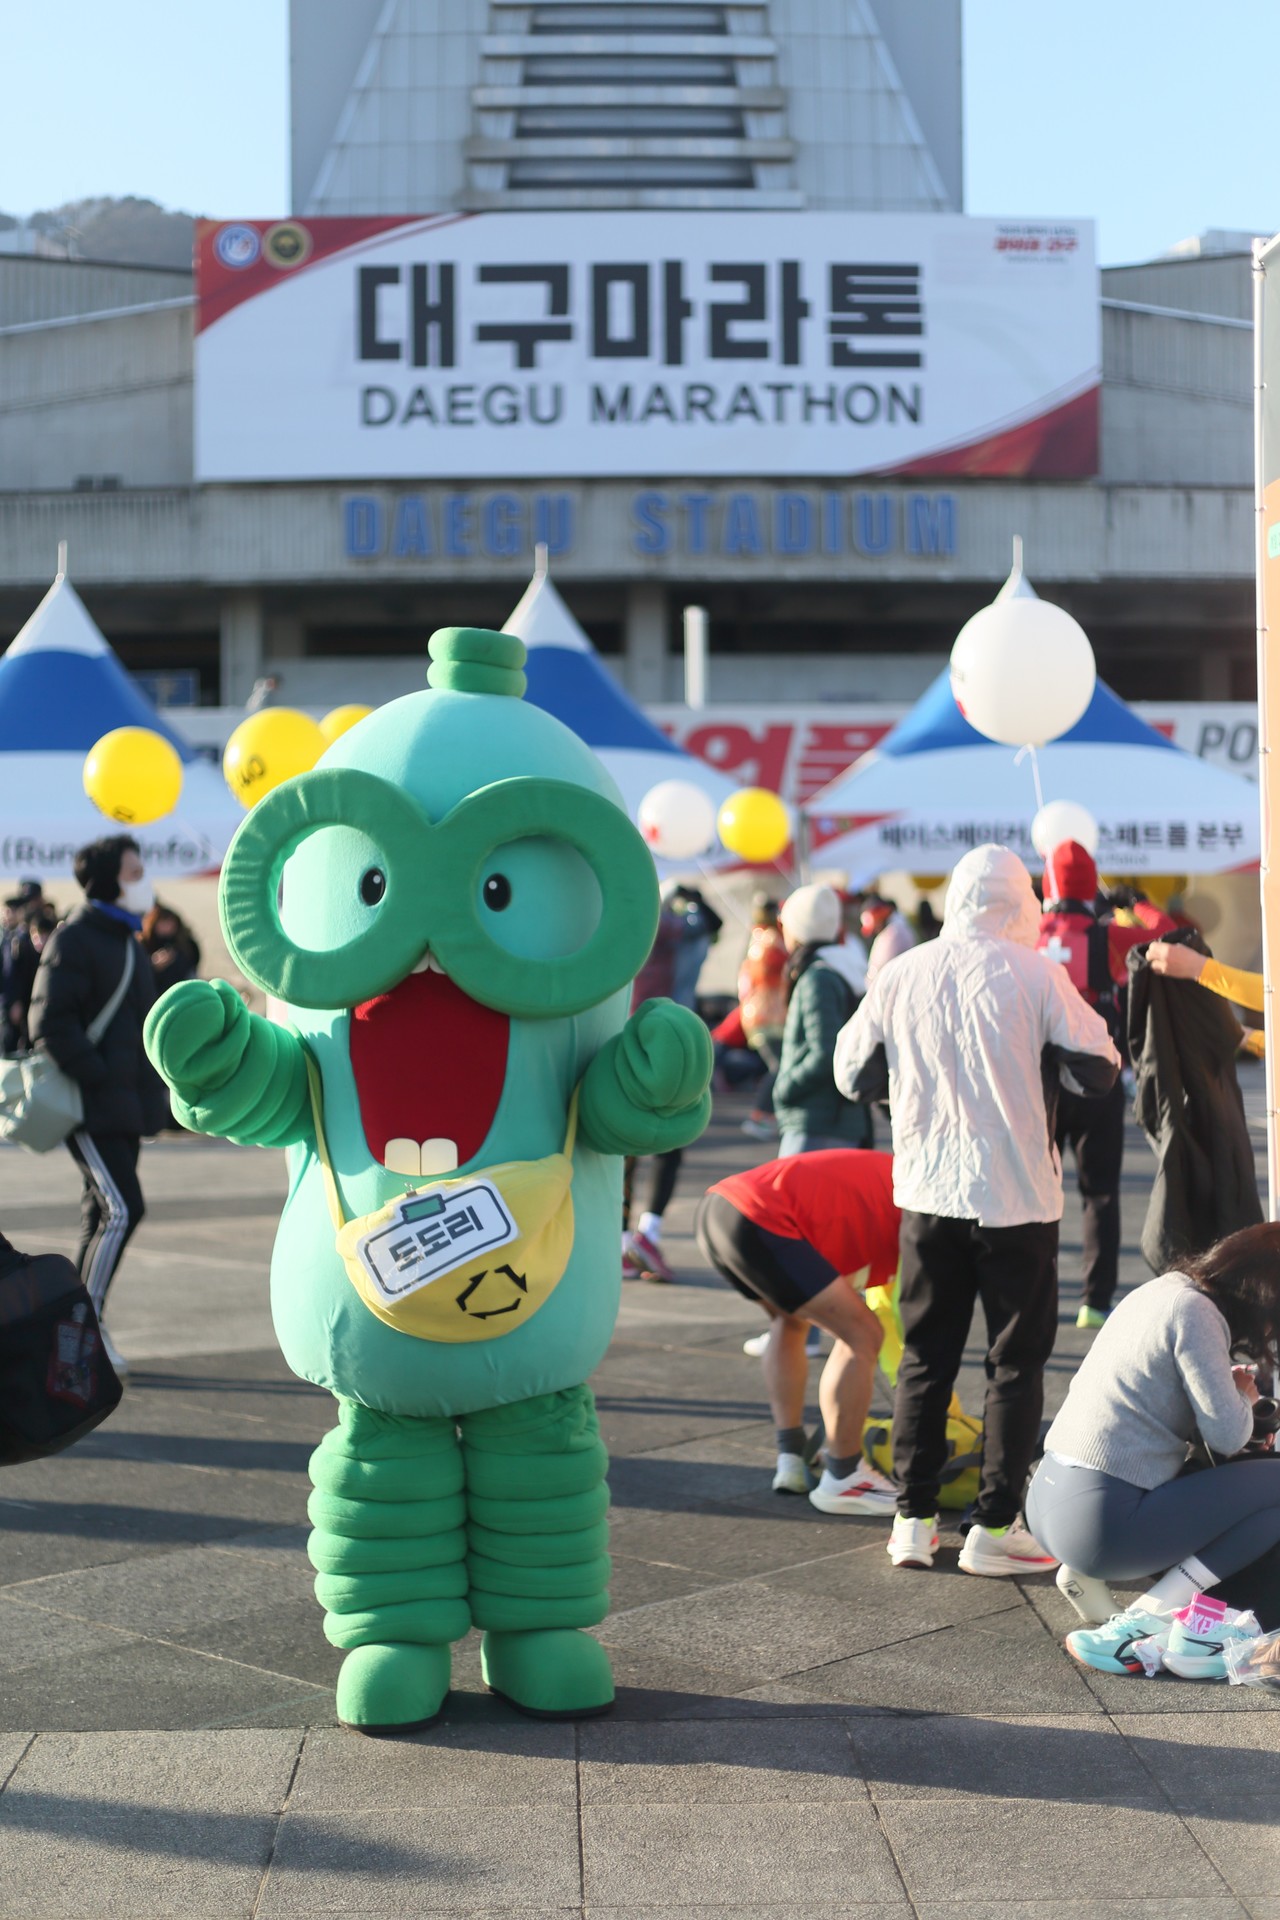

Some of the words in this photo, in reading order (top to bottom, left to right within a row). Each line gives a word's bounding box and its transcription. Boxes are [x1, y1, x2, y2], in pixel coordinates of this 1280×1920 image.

[357, 260, 923, 369] 대구마라톤
[361, 385, 563, 427] DAEGU
[591, 384, 922, 426] MARATHON
[345, 491, 574, 558] DAEGU
[635, 491, 957, 558] STADIUM
[388, 1204, 485, 1273] 도도리
